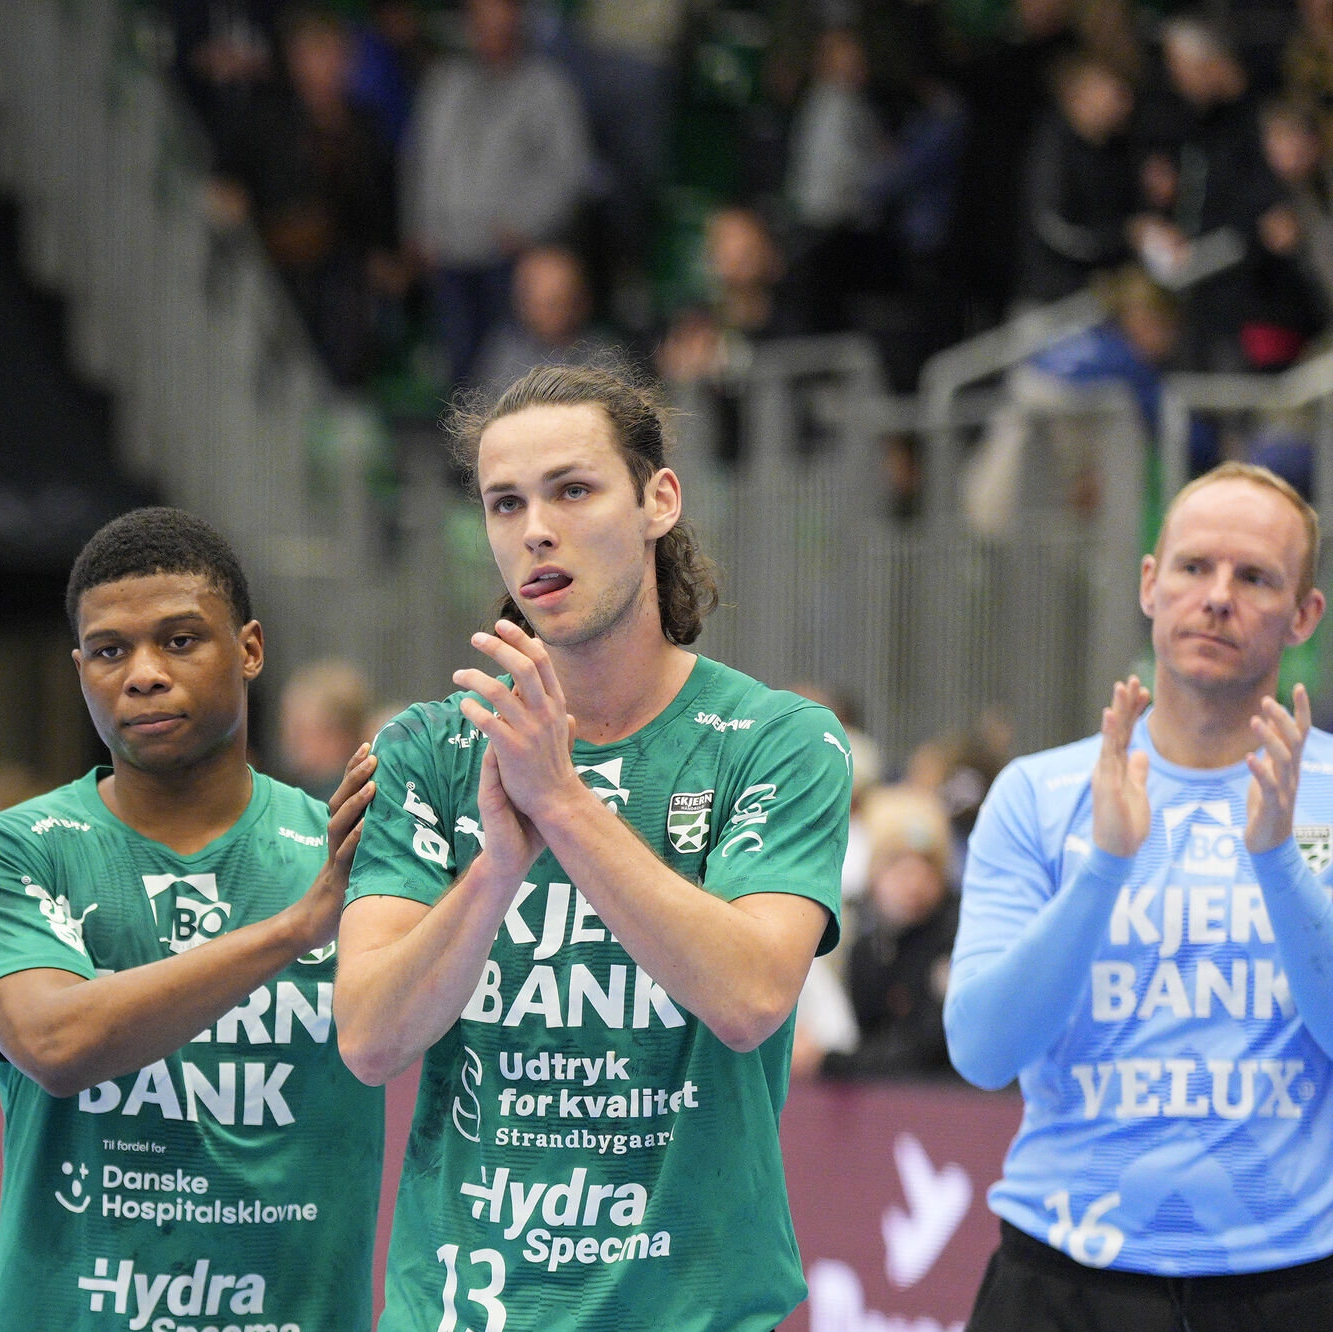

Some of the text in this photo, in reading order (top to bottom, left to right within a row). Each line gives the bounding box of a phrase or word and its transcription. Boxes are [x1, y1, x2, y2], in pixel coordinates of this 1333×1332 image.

[674, 793, 713, 808] SKJERN
[491, 882, 620, 961] KJE
[1109, 884, 1276, 958] KJER
[461, 963, 687, 1029] BANK
[1091, 959, 1299, 1022] BANK
[499, 1051, 631, 1087] Udtryk
[1071, 1058, 1305, 1119] VELUX
[497, 1080, 699, 1119] for kvalitet
[102, 1139, 167, 1154] Til fordel for
[495, 1125, 675, 1155] Strandbygaar
[102, 1165, 209, 1194] Danske
[460, 1166, 649, 1241] Hydra
[101, 1194, 318, 1227] Hospitalsklovne
[1043, 1190, 1125, 1268] 16
[522, 1228, 671, 1273] Specma
[78, 1258, 267, 1330] Hydra
